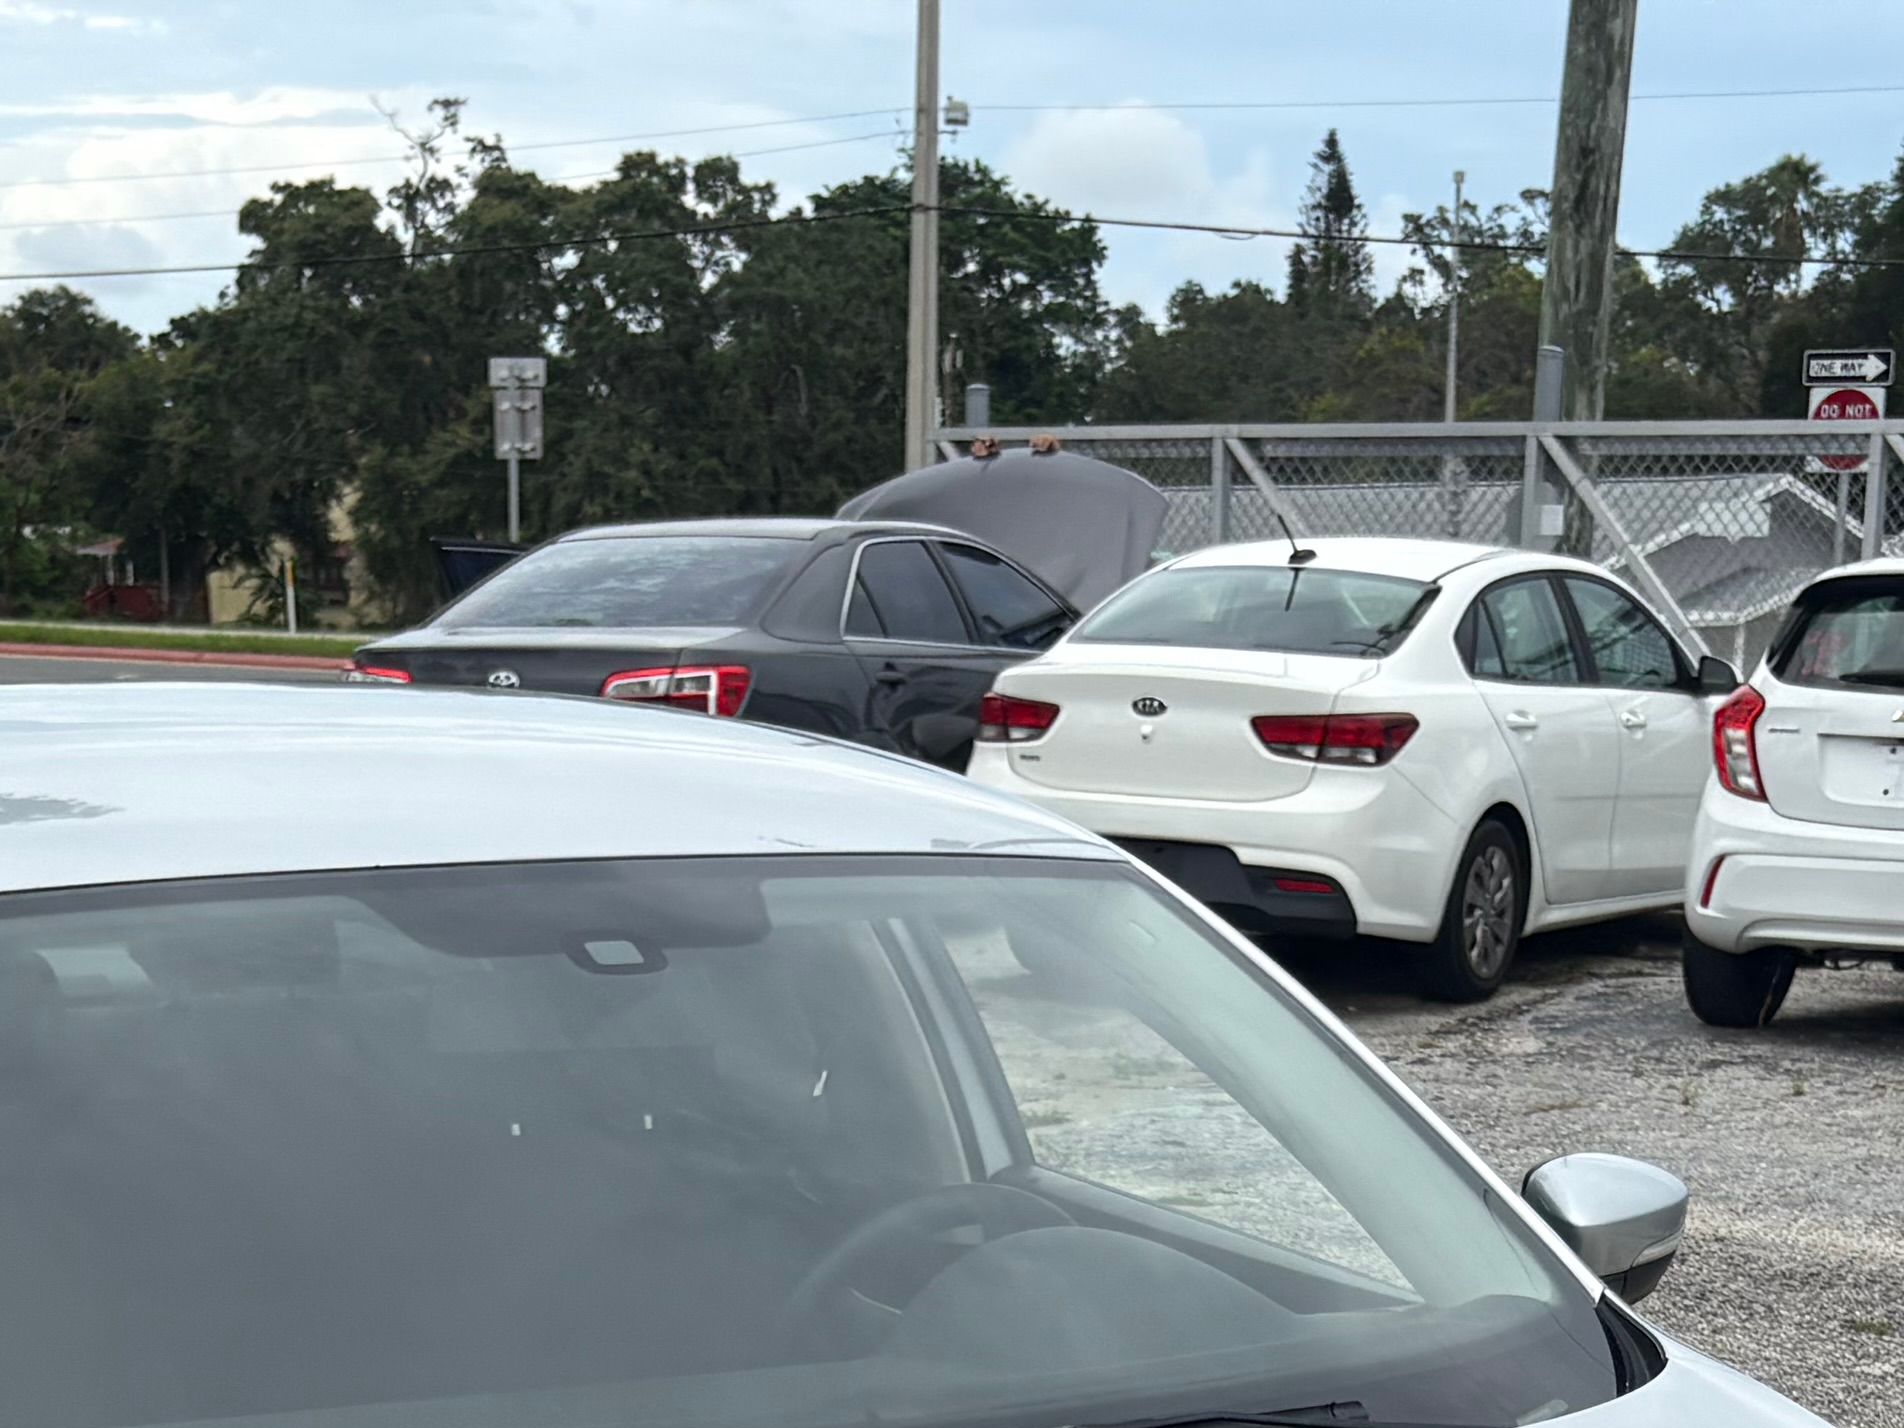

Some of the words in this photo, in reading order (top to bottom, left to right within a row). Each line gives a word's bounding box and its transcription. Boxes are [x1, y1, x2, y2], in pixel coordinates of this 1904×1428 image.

[1812, 362, 1836, 375] ONE
[1839, 362, 1864, 373] WAY
[1820, 404, 1839, 418] DO
[1845, 404, 1872, 418] NOT
